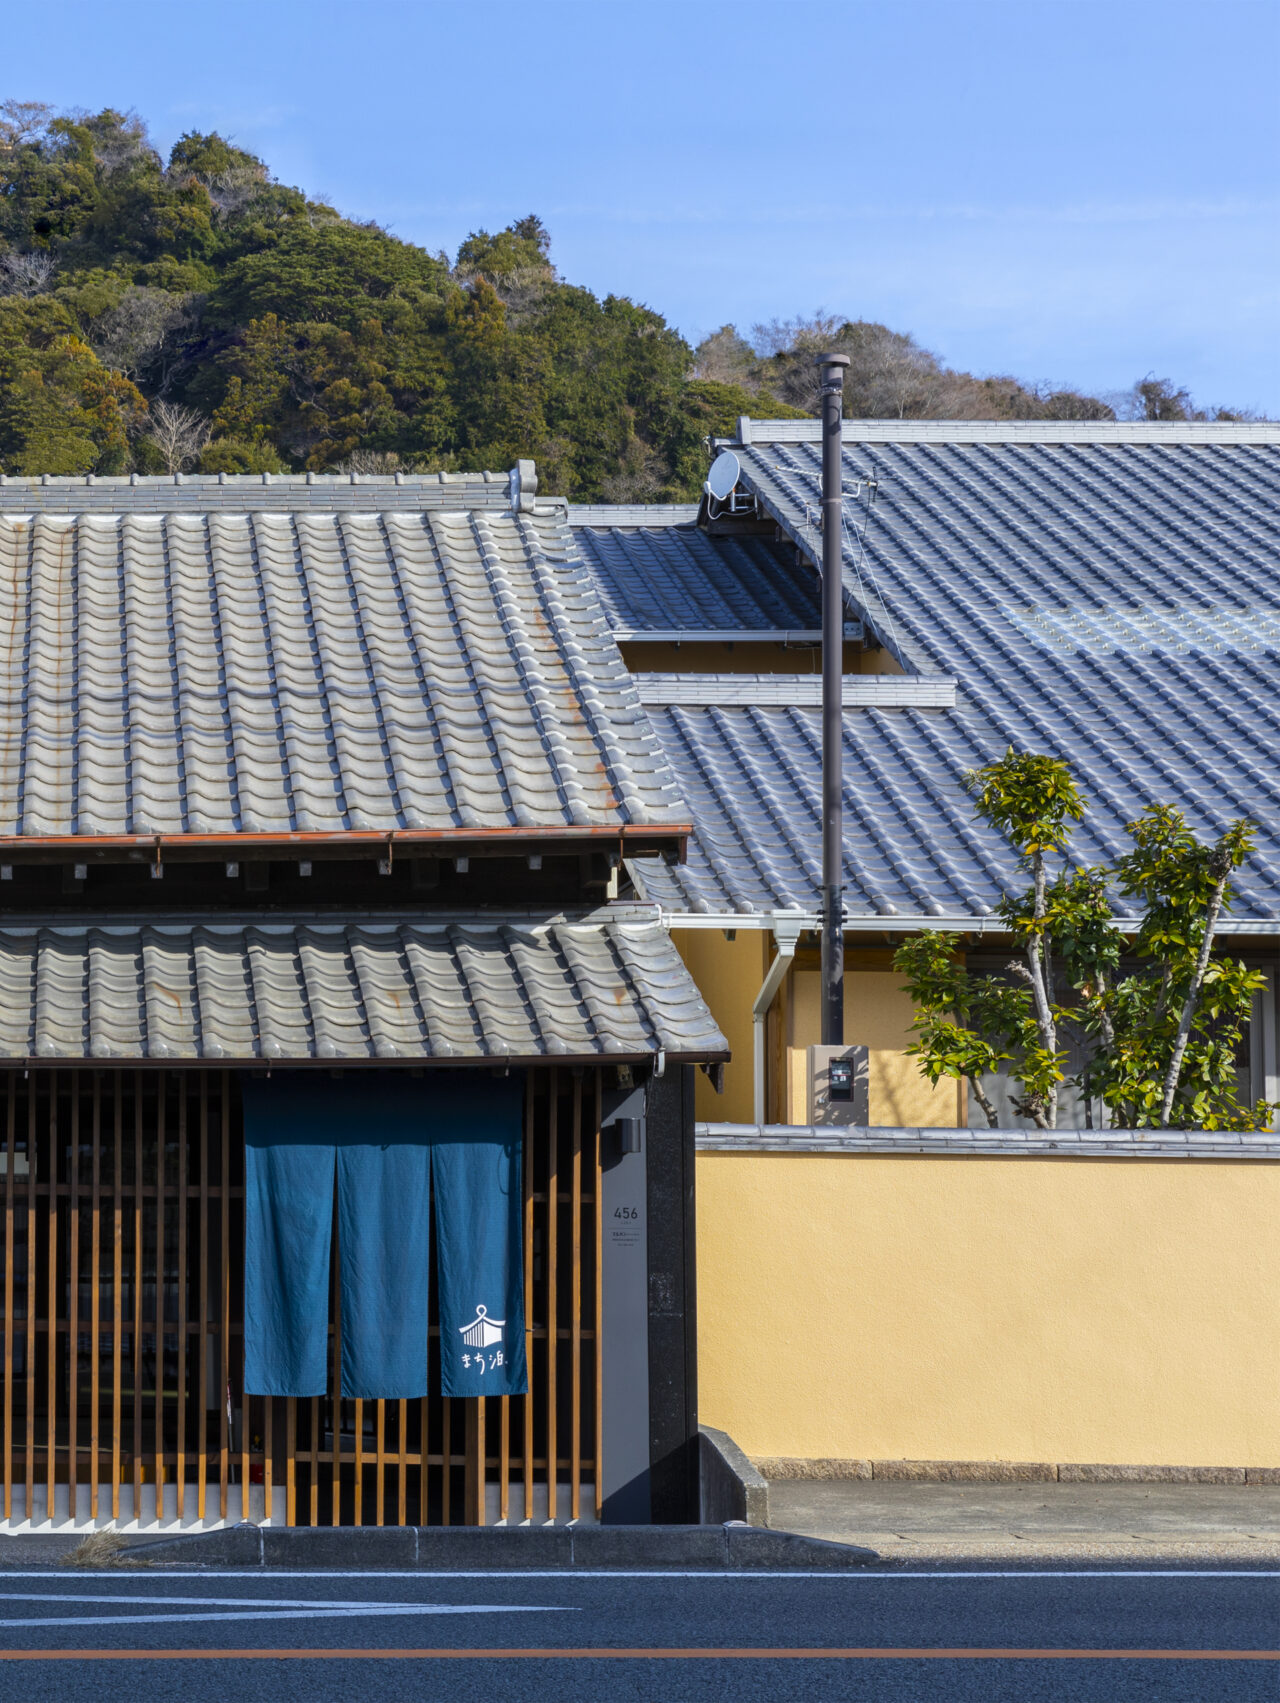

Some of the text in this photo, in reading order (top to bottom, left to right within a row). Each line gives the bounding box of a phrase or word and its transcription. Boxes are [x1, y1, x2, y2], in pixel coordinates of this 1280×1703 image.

[614, 1207, 638, 1219] 456
[461, 1350, 504, 1375] まち泊
